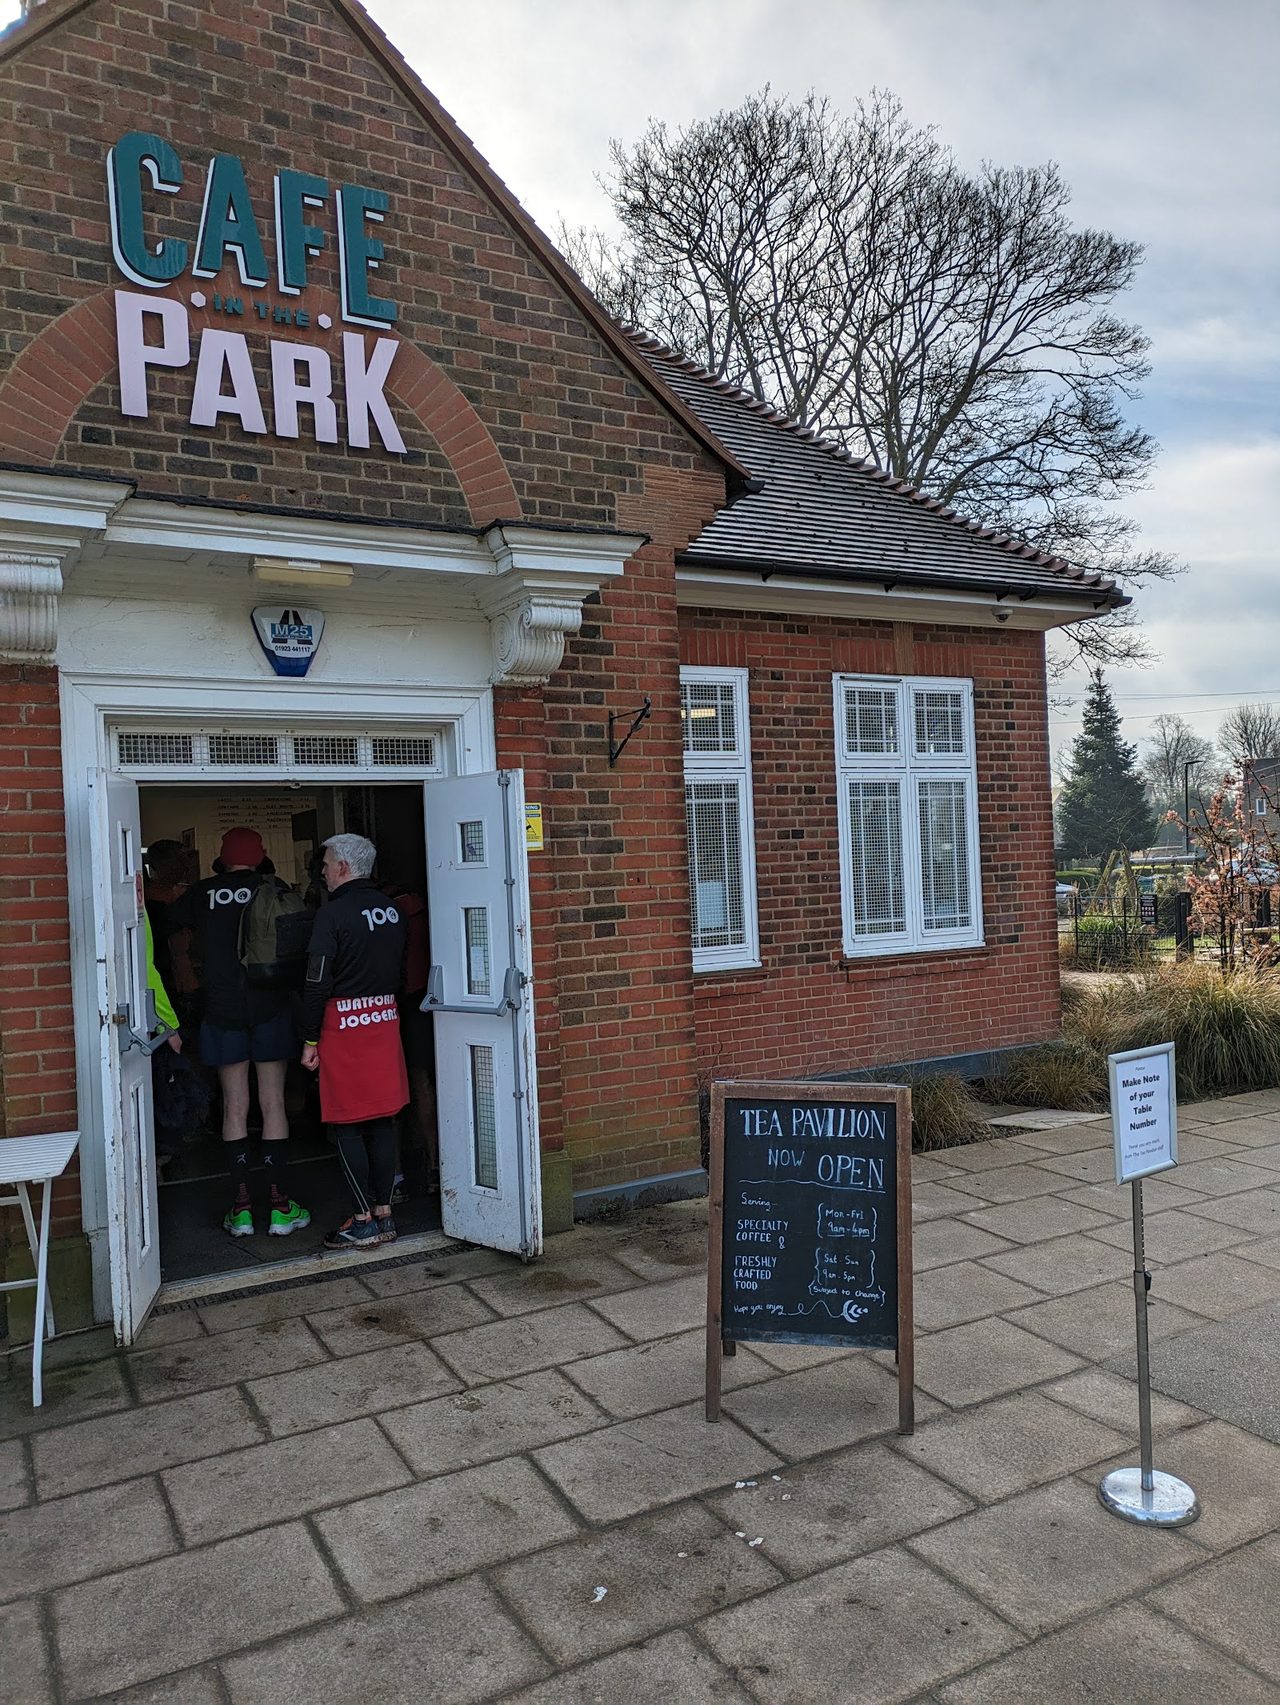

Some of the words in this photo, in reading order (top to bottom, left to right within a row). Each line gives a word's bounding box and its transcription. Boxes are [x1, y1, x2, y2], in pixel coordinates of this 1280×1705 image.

[107, 131, 398, 330] CAFE
[213, 293, 244, 315] IN
[254, 301, 310, 328] THE
[115, 290, 408, 454] PARK
[275, 624, 308, 635] M25
[206, 887, 252, 910] 100
[361, 906, 399, 931] 100
[336, 994, 395, 1012] WATFORD
[1122, 1078, 1141, 1088] Make
[1143, 1074, 1160, 1084] Note
[1129, 1092, 1138, 1101] of
[1139, 1090, 1155, 1102] your
[1133, 1104, 1152, 1115] Table
[740, 1109, 783, 1137] TEA
[792, 1108, 886, 1140] PAVILION
[1130, 1118, 1157, 1131] Number
[768, 1148, 805, 1167] NOW
[817, 1154, 884, 1189] OPEN
[737, 1219, 789, 1231] SPECIALTY
[736, 1231, 771, 1242] COFFEE
[778, 1235, 785, 1249] &
[735, 1255, 777, 1268] FRESHLY
[733, 1268, 772, 1280] CRAFTED
[735, 1280, 758, 1290] FOOD
